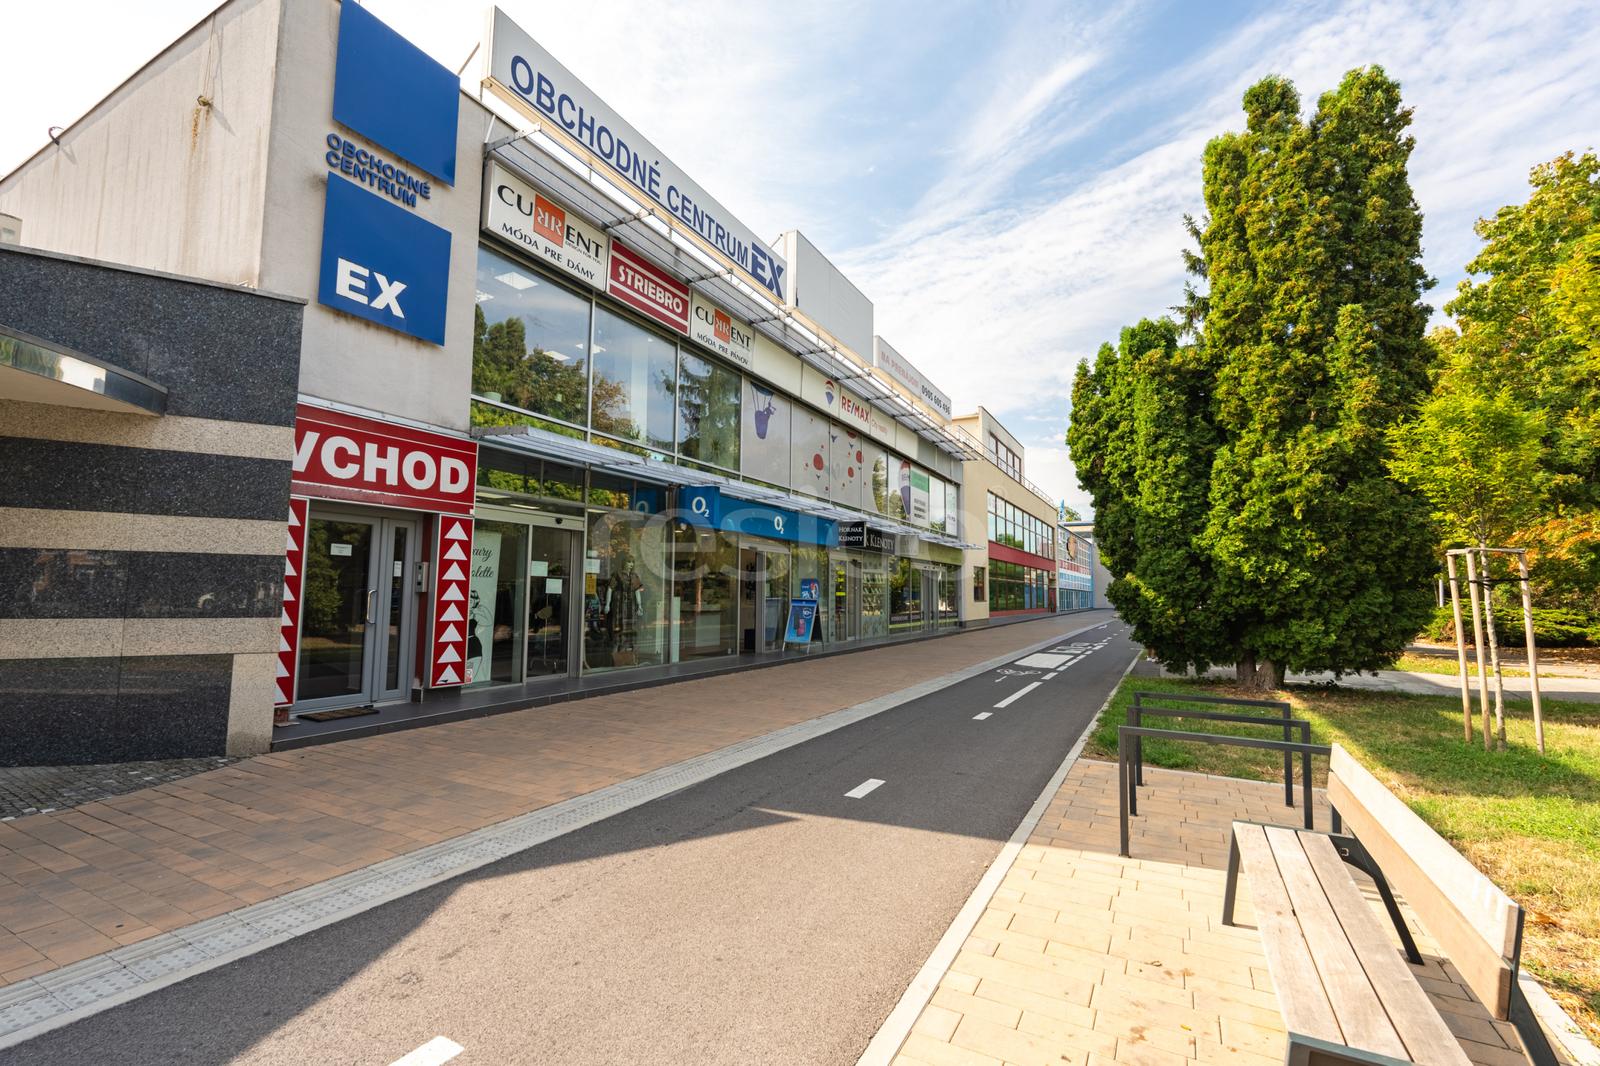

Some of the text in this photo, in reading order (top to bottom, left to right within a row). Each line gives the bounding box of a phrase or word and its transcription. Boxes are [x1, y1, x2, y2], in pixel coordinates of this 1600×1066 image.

[325, 150, 417, 208] CENTRUM
[326, 133, 431, 200] OBCHODNÉ
[511, 55, 785, 300] OBCHODNÉ CENTRUM EX
[501, 222, 595, 280] MÓDA PRE DÁMY
[335, 257, 407, 319] EX
[618, 265, 683, 314] STRIEBRO
[697, 331, 717, 347] MÓDA
[718, 343, 728, 355] PRE
[841, 395, 870, 424] RE/MAX
[870, 533, 895, 551] KLENOTY
